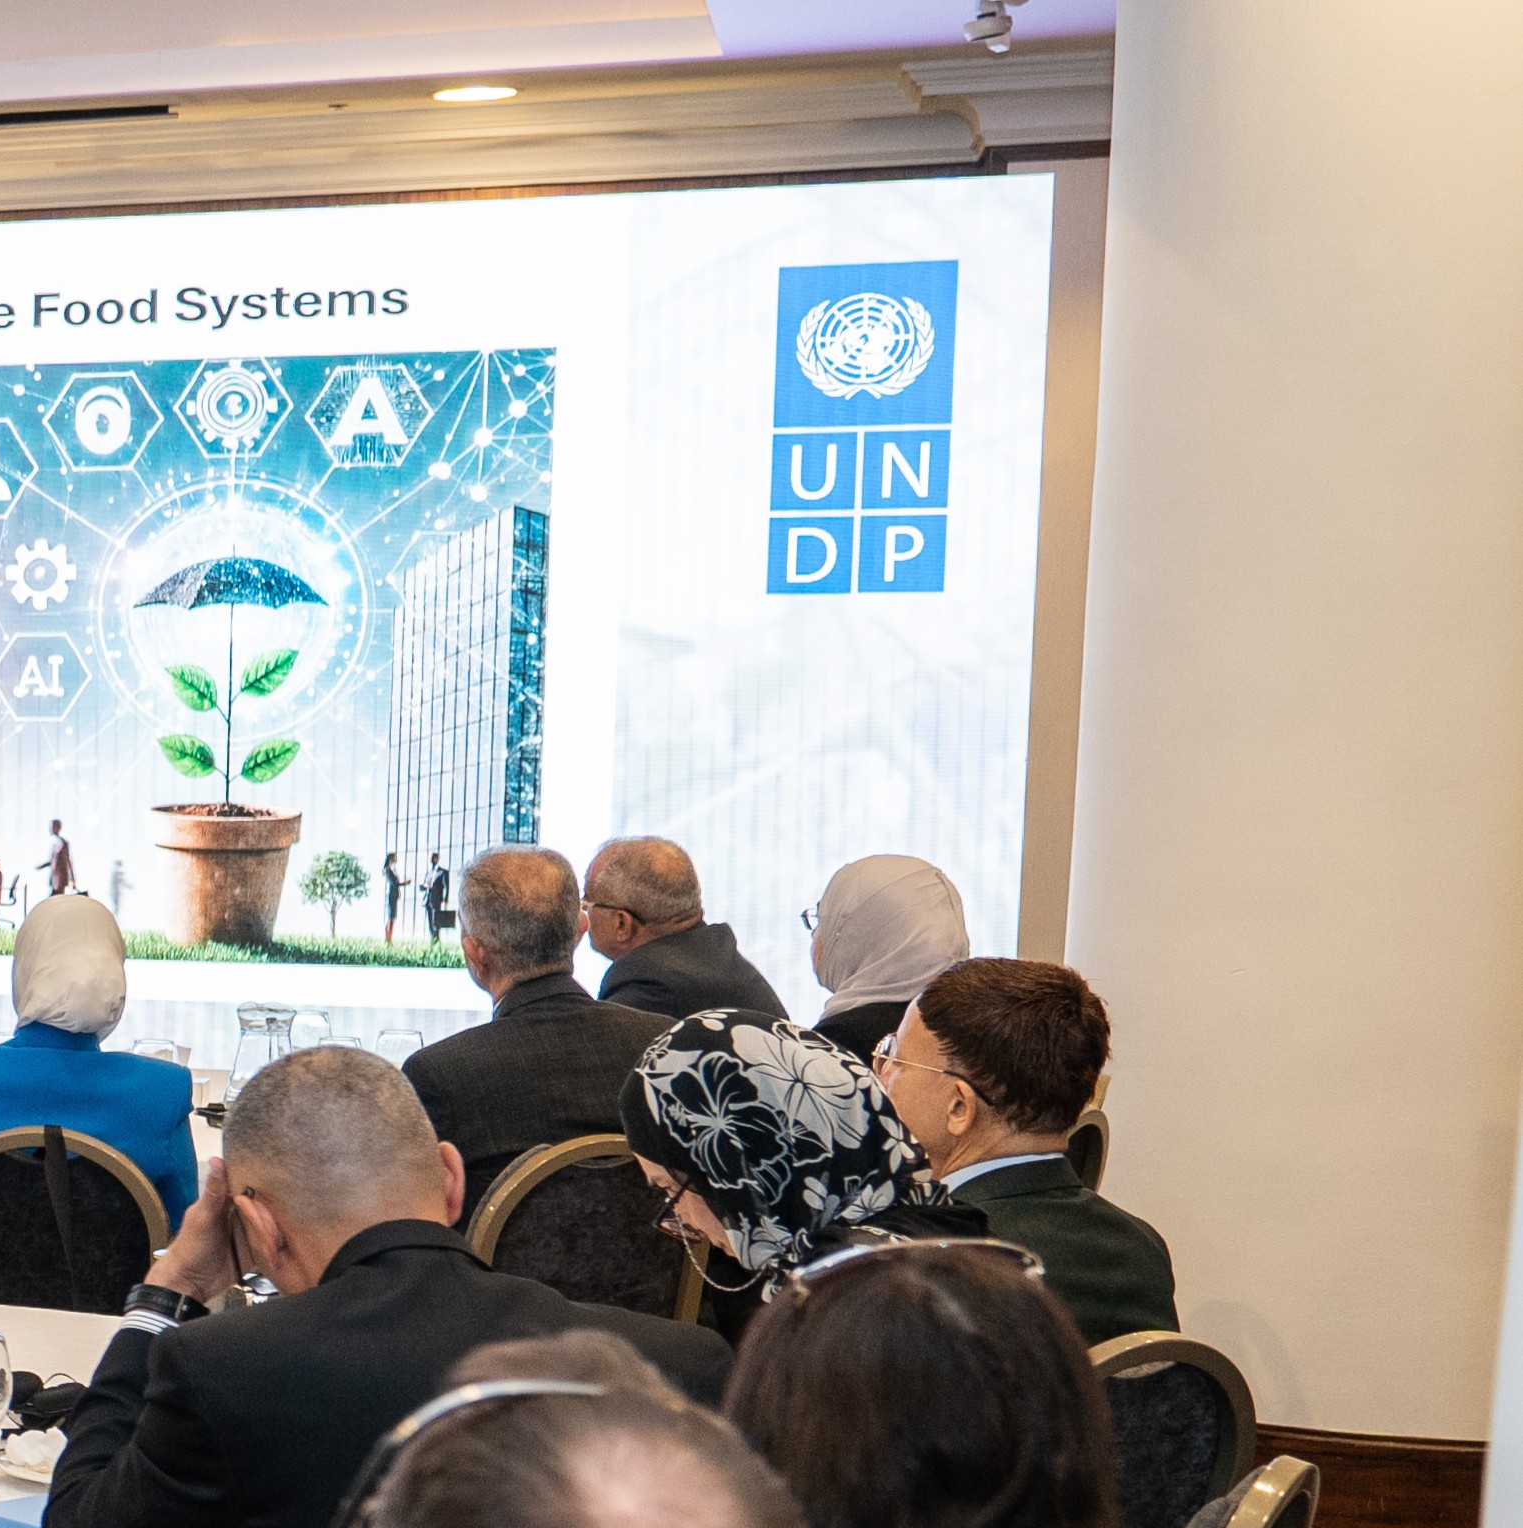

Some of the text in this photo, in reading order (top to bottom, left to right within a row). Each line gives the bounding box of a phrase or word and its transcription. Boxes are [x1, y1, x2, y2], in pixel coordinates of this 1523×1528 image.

[32, 288, 158, 328] Food
[174, 286, 409, 330] Systems
[13, 654, 65, 698] AI
